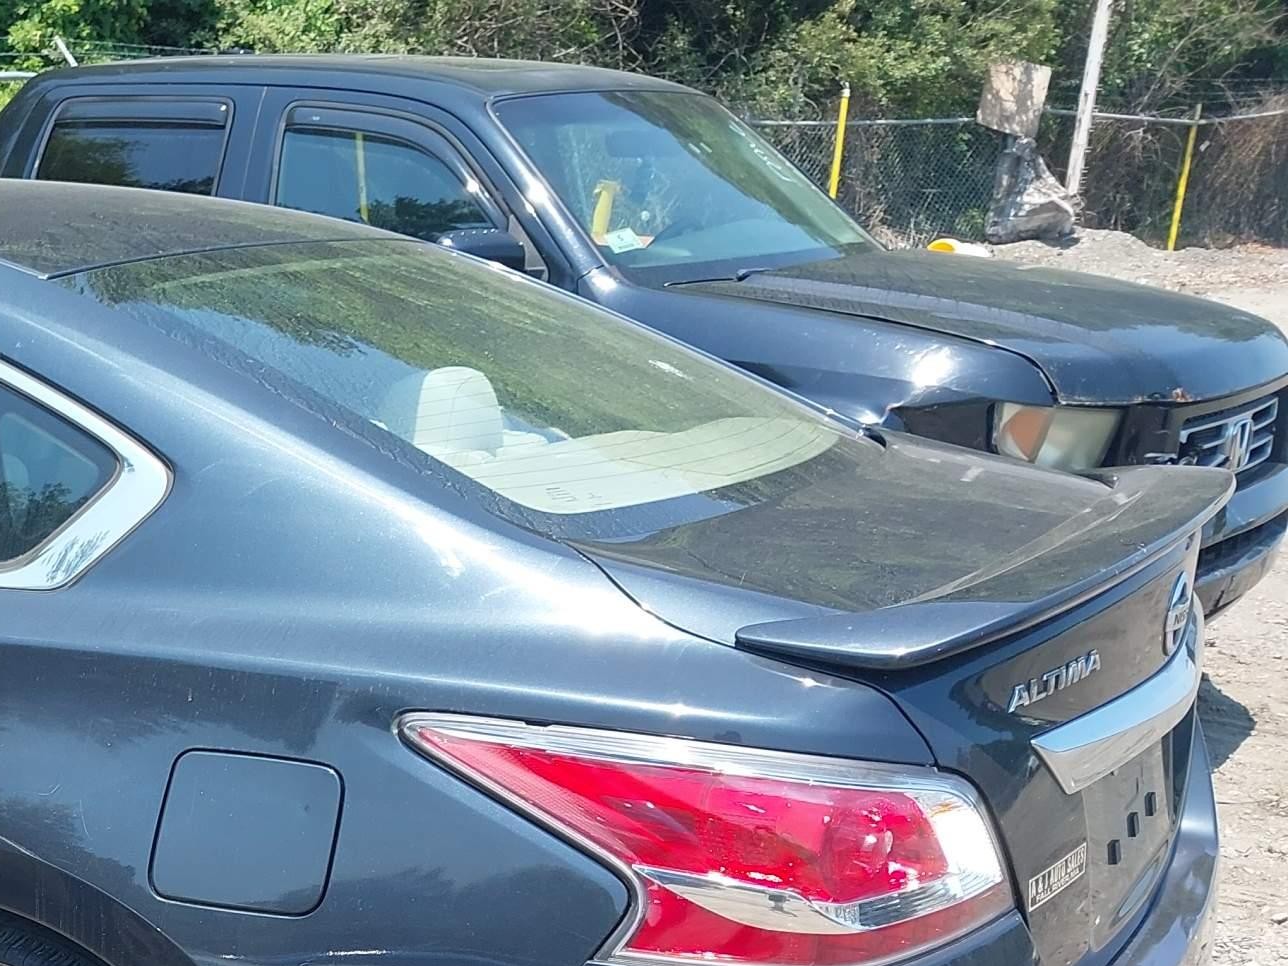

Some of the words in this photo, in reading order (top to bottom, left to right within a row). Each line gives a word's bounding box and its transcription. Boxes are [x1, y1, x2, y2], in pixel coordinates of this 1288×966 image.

[1007, 648, 1102, 713] ALTIMA
[1037, 876, 1044, 893] &
[1049, 860, 1066, 886] AUTO
[1067, 847, 1085, 873] SALES
[1036, 888, 1052, 903] FALL
